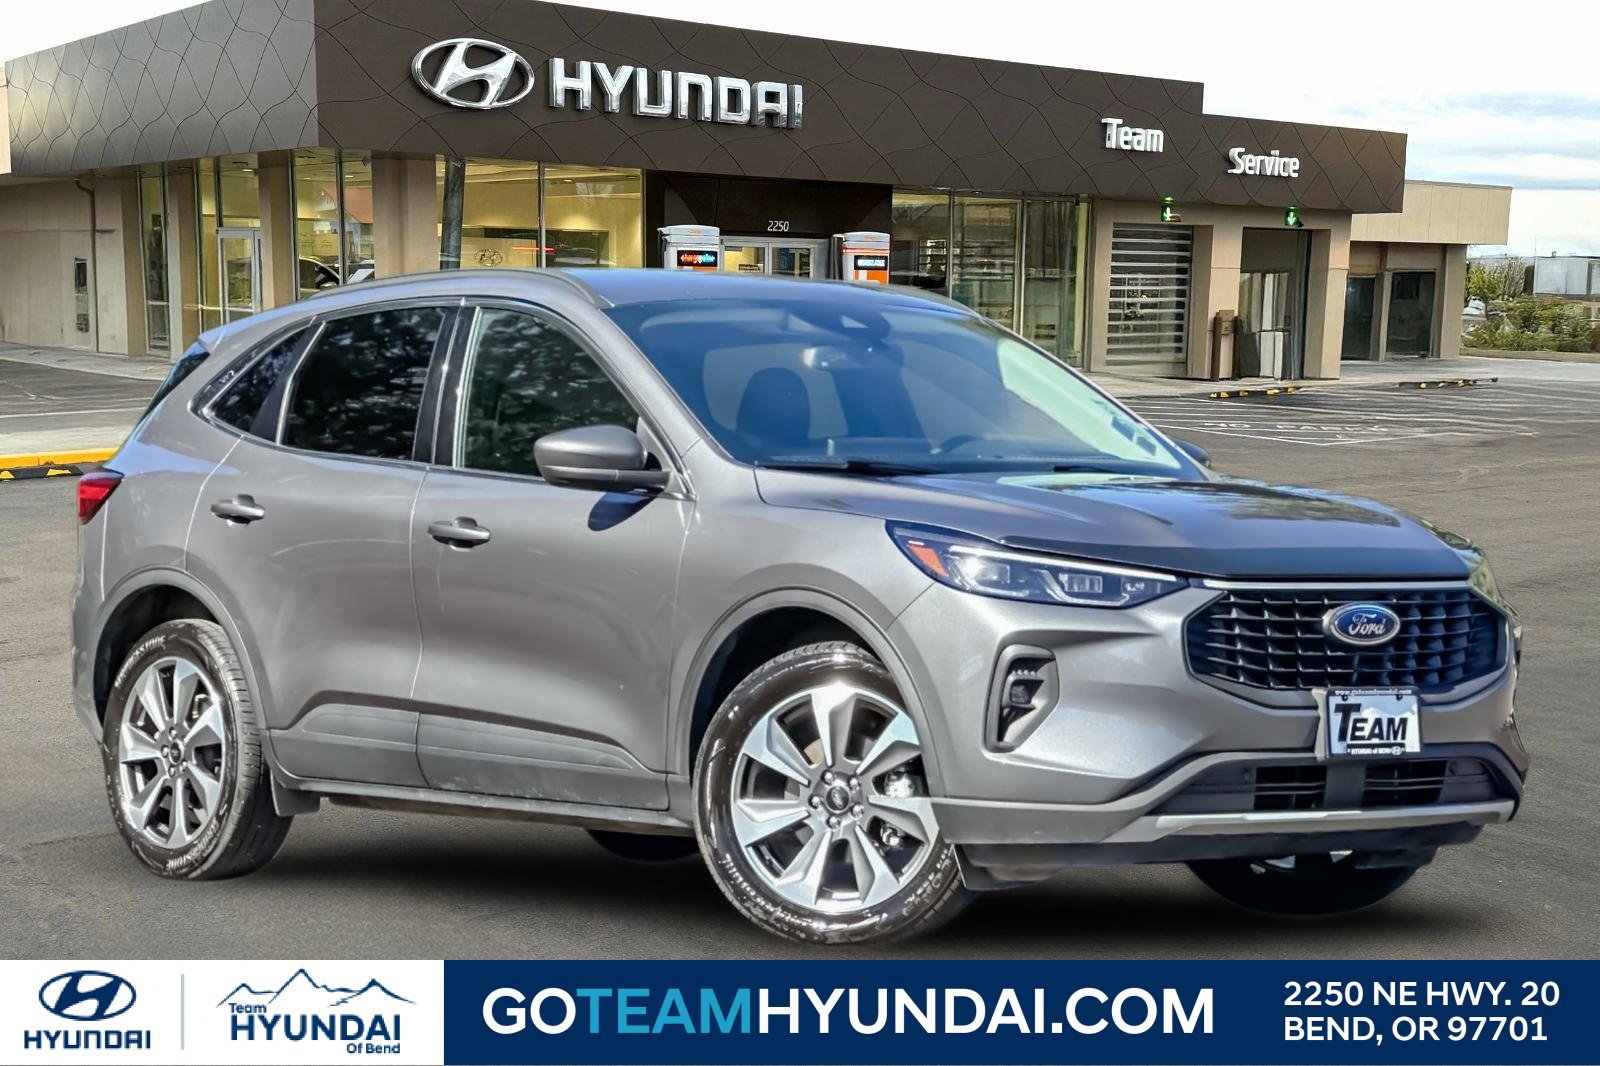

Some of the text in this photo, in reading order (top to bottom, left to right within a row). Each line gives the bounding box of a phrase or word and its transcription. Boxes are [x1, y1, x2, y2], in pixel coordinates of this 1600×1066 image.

[549, 57, 804, 129] HYUNDAI
[1101, 117, 1165, 153] Team
[1227, 147, 1300, 178] Service
[767, 220, 790, 232] 2250
[1348, 613, 1386, 636] Ford
